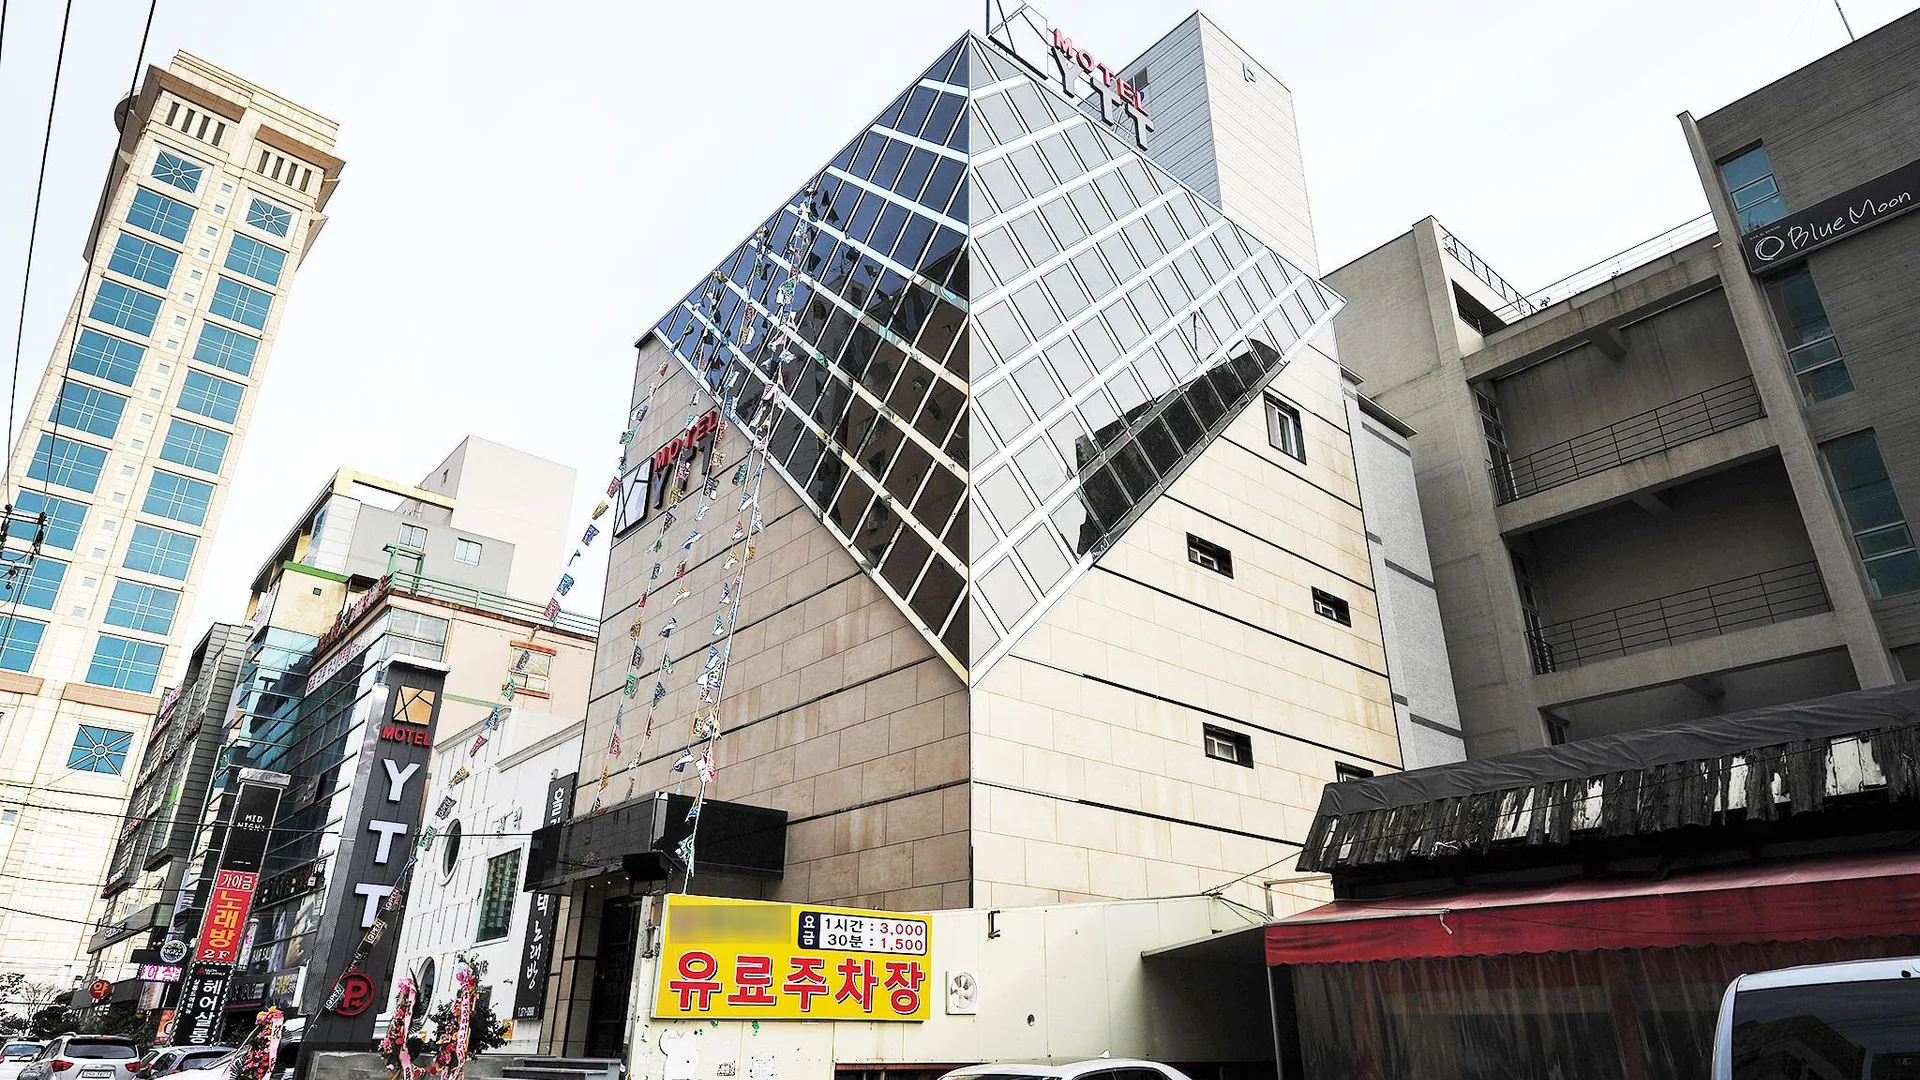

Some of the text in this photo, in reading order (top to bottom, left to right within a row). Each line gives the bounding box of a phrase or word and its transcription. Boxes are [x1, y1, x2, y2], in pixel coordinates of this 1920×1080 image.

[1053, 28, 1149, 118] MOTEL
[1050, 46, 1154, 152] YTT
[1788, 217, 1845, 250] Blue
[1849, 191, 1911, 224] Moon
[655, 411, 718, 472] MOTEL
[382, 725, 433, 747] MOTEL
[244, 814, 263, 823] MID
[220, 873, 253, 890] 가야금
[385, 888, 400, 911] OPEN
[209, 890, 243, 948] 노래방
[802, 915, 816, 946] 요금
[825, 917, 864, 934] 1시간
[367, 921, 383, 944] OPEN
[828, 933, 863, 949] 30분
[202, 949, 230, 960] 2F
[526, 920, 543, 990] 노래방
[93, 981, 110, 997] 약
[669, 951, 926, 1015] 유료주차장
[325, 986, 343, 1009] OPEN
[189, 979, 223, 1044] 헤어살롱
